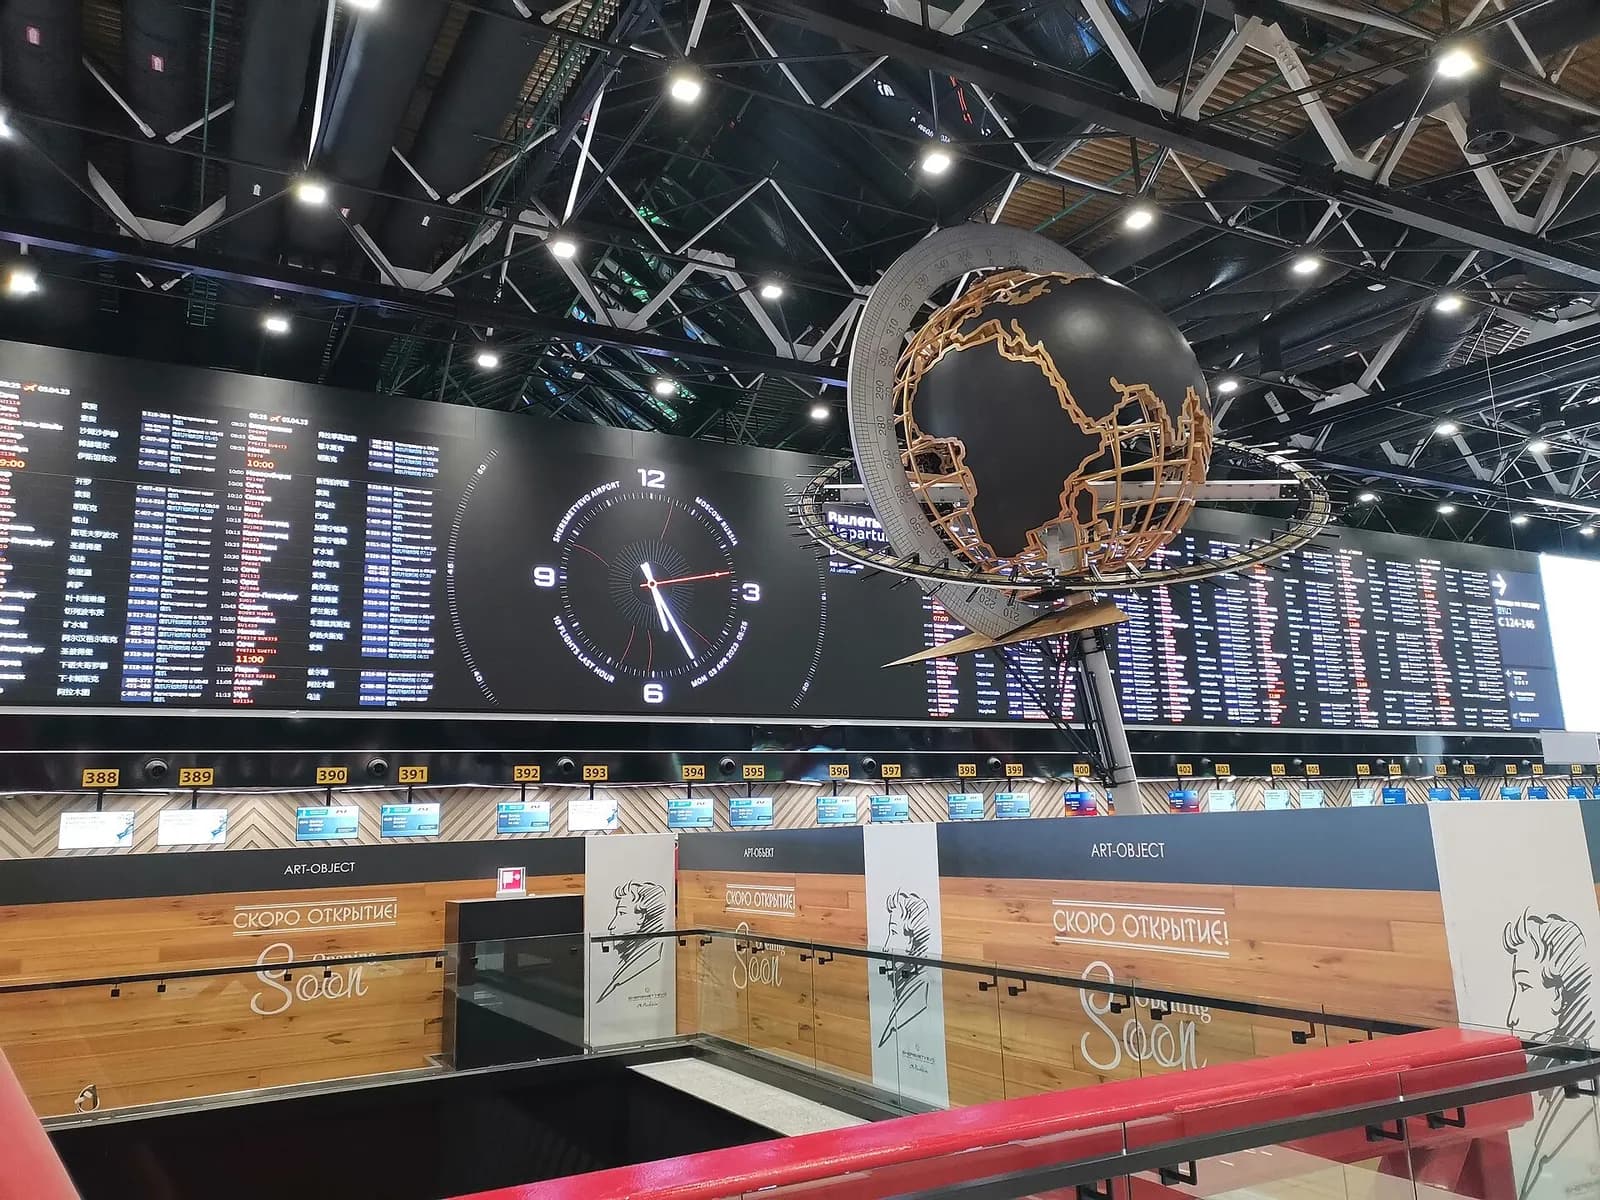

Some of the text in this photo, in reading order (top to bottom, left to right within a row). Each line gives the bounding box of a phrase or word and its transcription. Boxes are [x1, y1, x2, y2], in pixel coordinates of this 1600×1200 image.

[899, 294, 912, 311] 320
[887, 318, 898, 336] 310
[879, 347, 888, 367] 300
[876, 380, 884, 400] 290
[877, 415, 886, 436] 280
[0, 459, 25, 468] 9:00
[247, 460, 274, 468] 10:00
[638, 468, 665, 489] 12
[553, 481, 620, 543] SHEREMETYEVO AIRPORT
[695, 496, 738, 546] MOSCOW RUSSIA
[910, 517, 925, 537] 250
[829, 525, 890, 542] epartu
[534, 567, 555, 587] 9
[742, 583, 760, 601] 3
[979, 594, 996, 609] 220
[1003, 608, 1020, 621] 210
[1498, 617, 1504, 626] C
[553, 616, 615, 683] 10 FLIGHTS LAST HOUR
[690, 674, 708, 688] MON
[708, 668, 718, 677] 03
[716, 657, 729, 670] APR
[726, 642, 739, 659] 2023
[643, 684, 664, 703] 6
[85, 772, 117, 784] 388
[182, 771, 211, 783] 389
[319, 770, 345, 781] 390
[401, 769, 425, 780] 391
[516, 769, 538, 778] 392
[585, 768, 606, 777] 393
[684, 768, 704, 777] 394
[744, 767, 763, 776] 395
[831, 767, 848, 775] 396
[883, 766, 900, 775] 397
[960, 766, 975, 774] 398
[1008, 766, 1022, 774] 399
[1075, 766, 1089, 774] 400
[743, 847, 774, 858] АРТ-ОБЪЕКТ
[1091, 842, 1165, 858] ART-OBJECT
[284, 862, 355, 875] ART-OBJECT
[726, 891, 795, 909] СКОРО ОТКРЫТИЕ!
[233, 903, 398, 929] СКОРО ОТКРЫТИЕ!
[1053, 909, 1229, 946] СКОРО ОТКРЫТИЕ!
[733, 922, 783, 989] Soon
[249, 942, 368, 1016] Soon
[1080, 960, 1208, 1071] Soon
